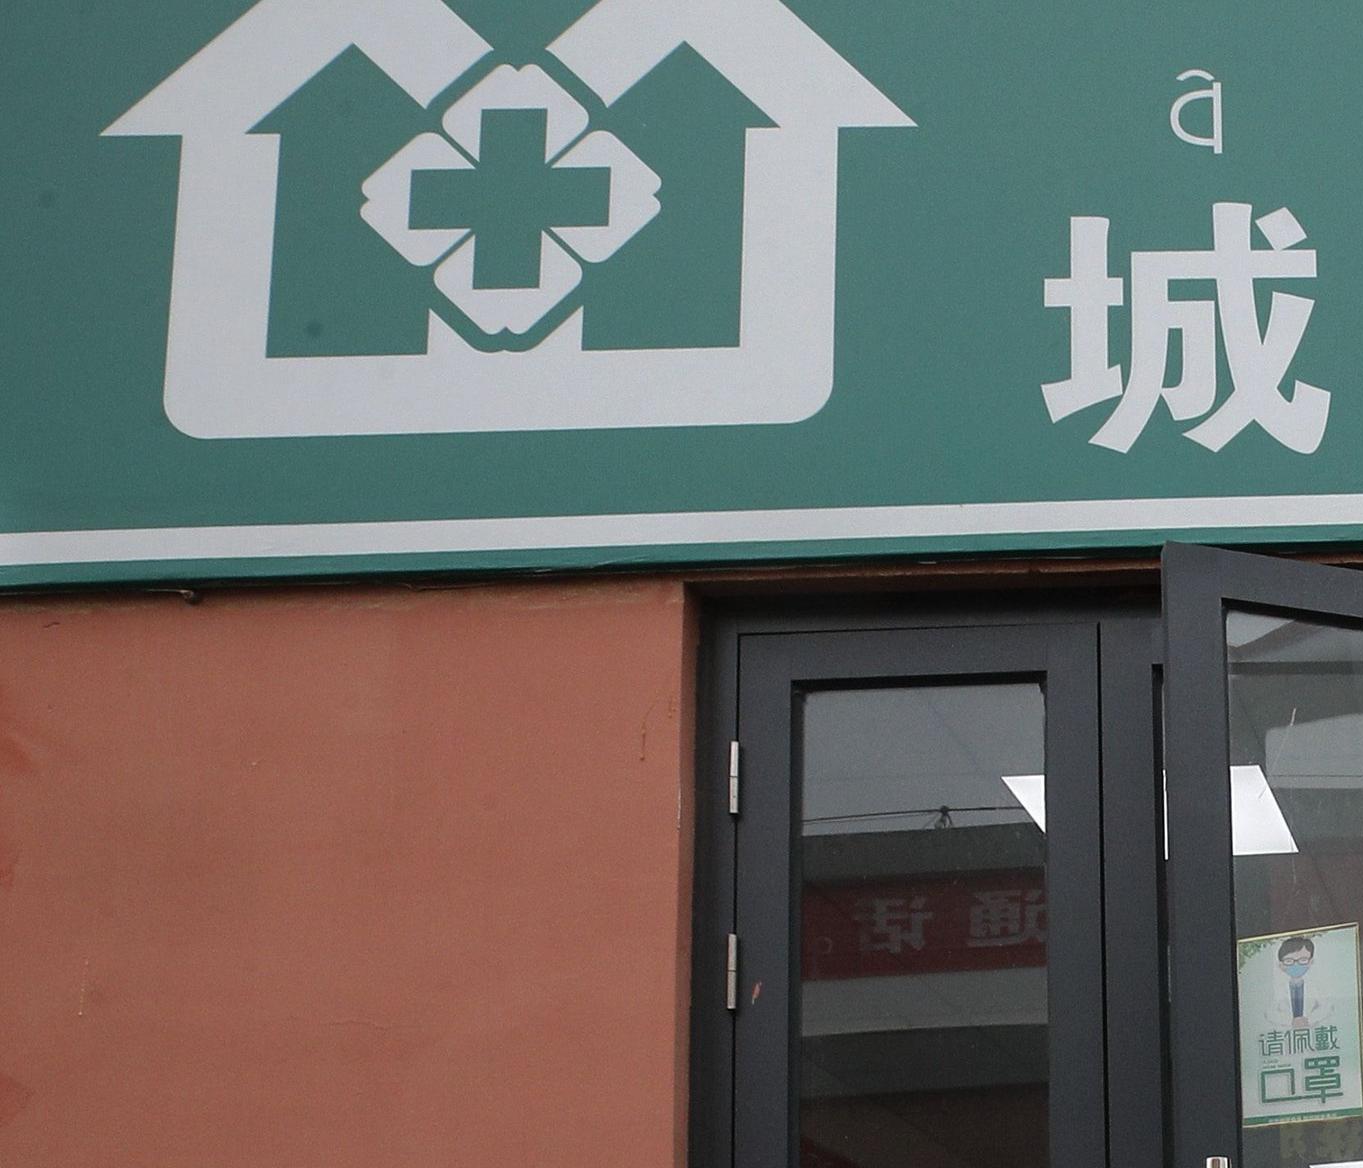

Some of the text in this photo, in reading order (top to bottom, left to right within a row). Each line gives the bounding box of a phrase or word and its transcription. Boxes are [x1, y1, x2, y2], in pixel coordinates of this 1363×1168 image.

[1259, 1025, 1340, 1057] 请佩戴
[1260, 1056, 1343, 1104] 口罩
